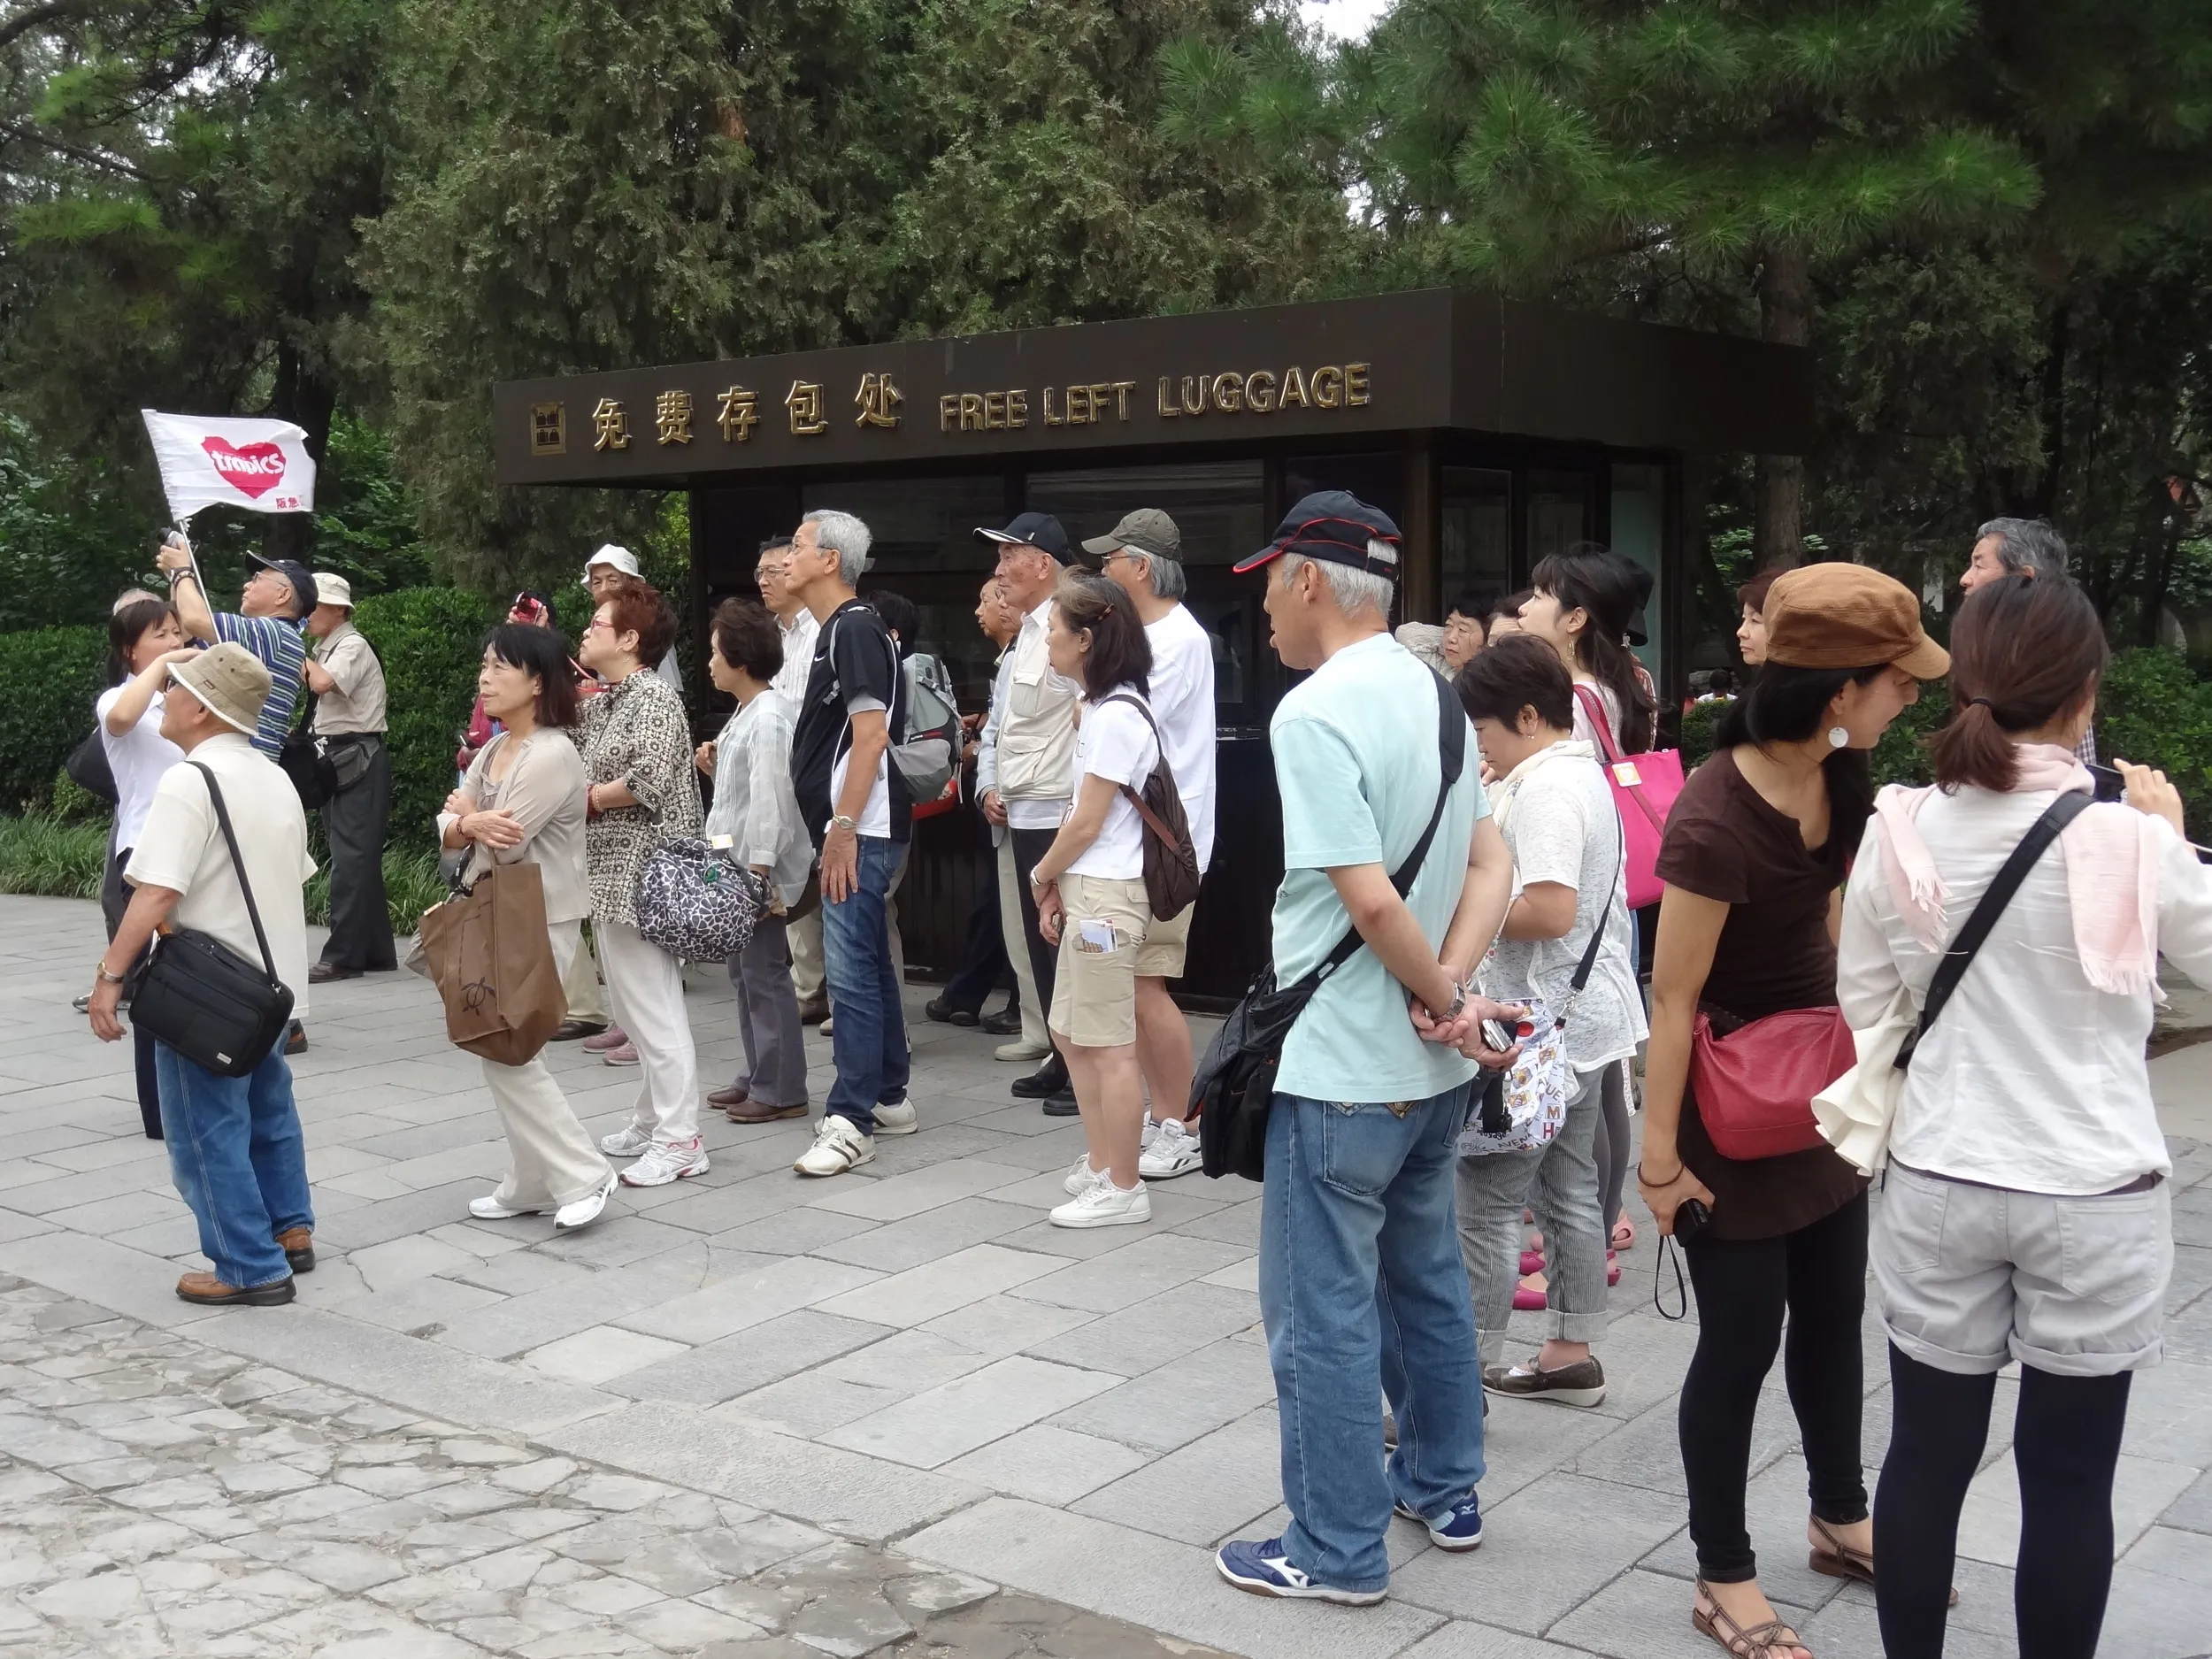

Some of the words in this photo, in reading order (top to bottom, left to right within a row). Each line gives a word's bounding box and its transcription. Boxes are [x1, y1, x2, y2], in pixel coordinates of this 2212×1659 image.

[591, 373, 902, 452] 免费存包处
[940, 389, 1028, 433] FREE
[1043, 380, 1137, 426] LEFT
[1157, 362, 1371, 418] LUGGAGE
